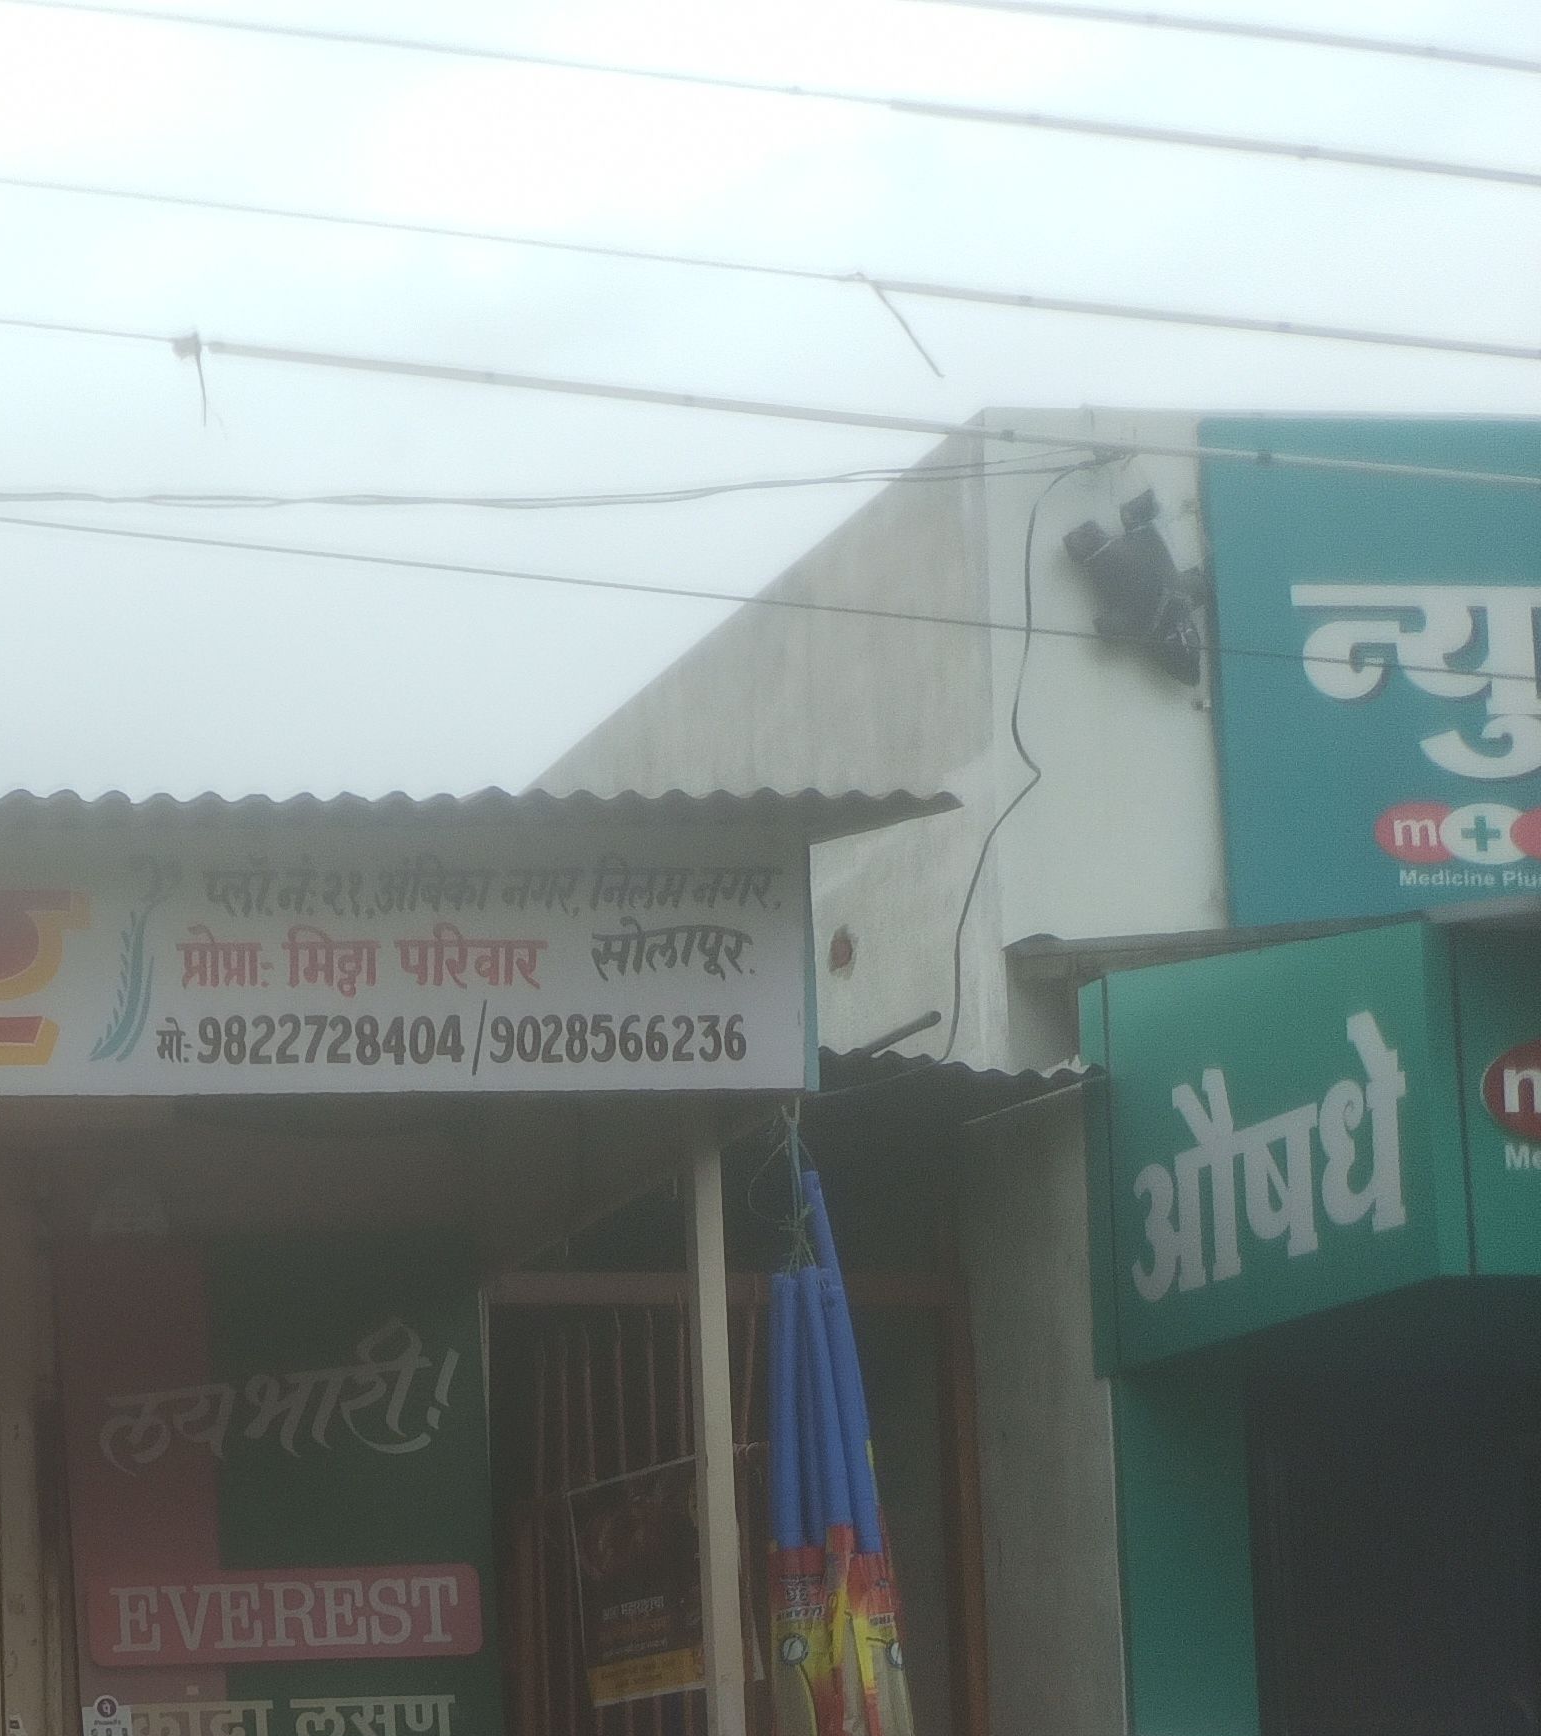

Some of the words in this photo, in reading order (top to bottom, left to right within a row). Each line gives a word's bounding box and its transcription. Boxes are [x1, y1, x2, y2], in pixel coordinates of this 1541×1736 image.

[1399, 870, 1495, 887] Medicine
[393, 921, 548, 989] परिवार
[109, 1575, 459, 1655] EVEREST
